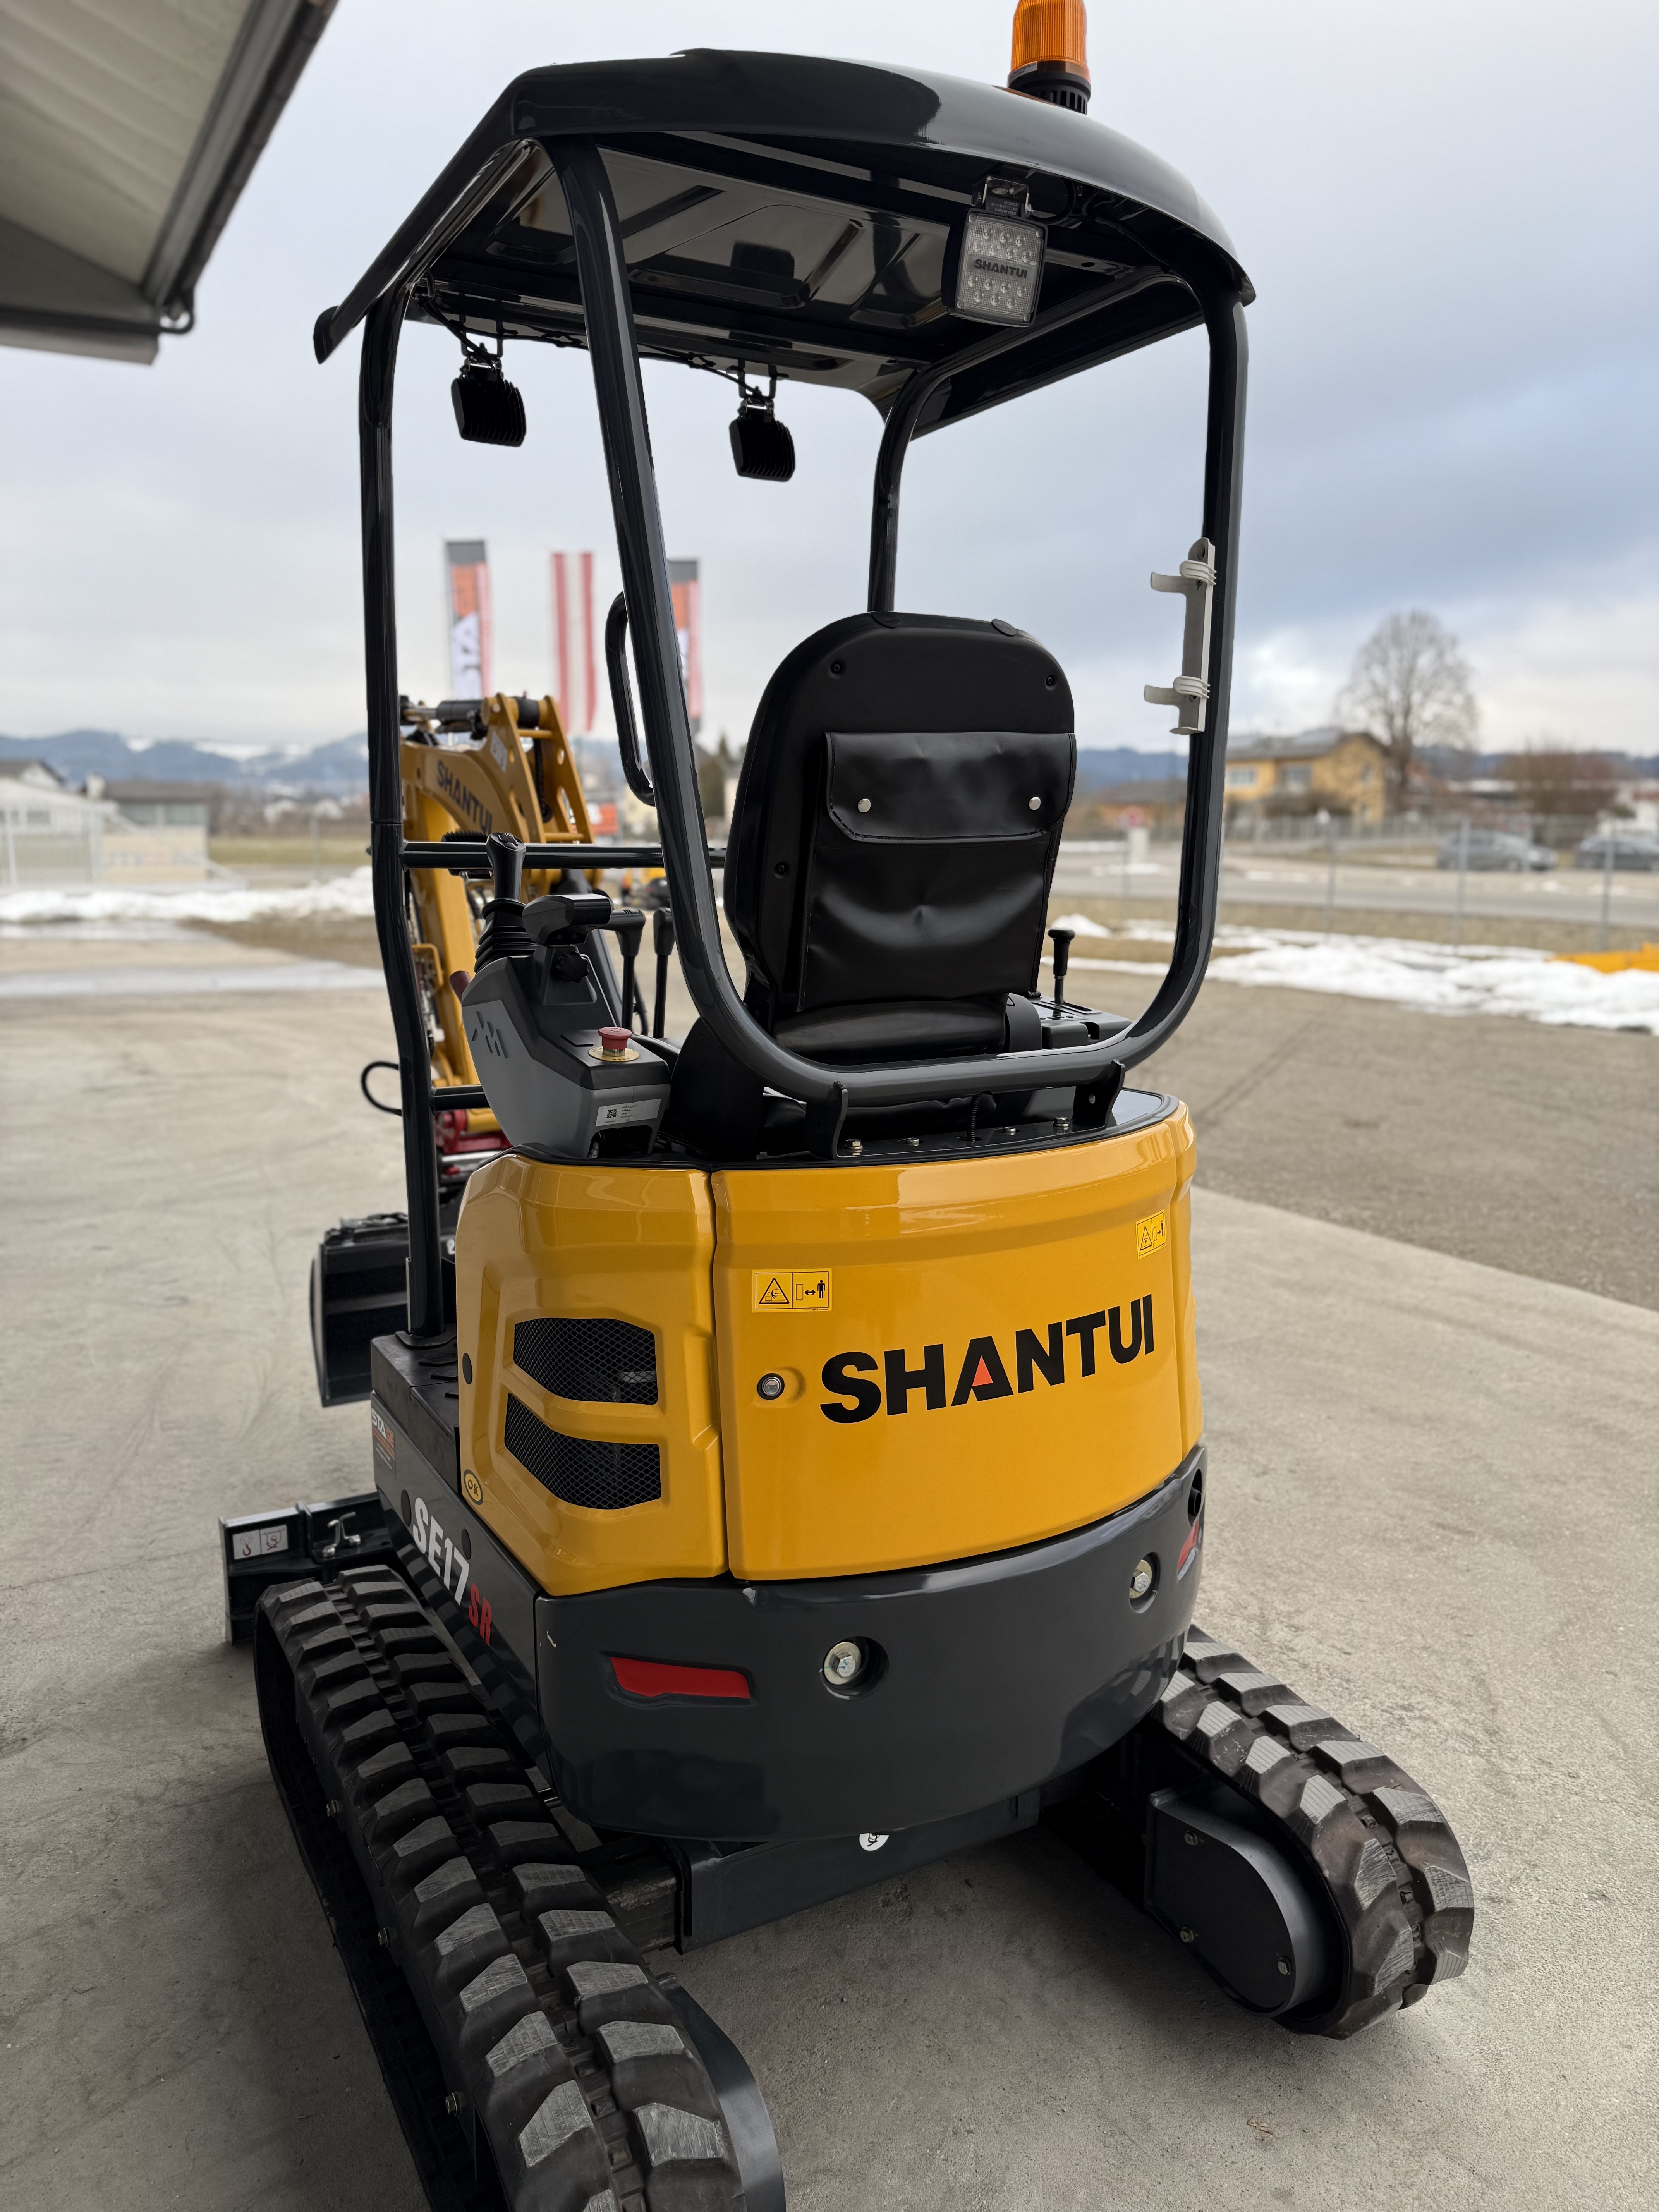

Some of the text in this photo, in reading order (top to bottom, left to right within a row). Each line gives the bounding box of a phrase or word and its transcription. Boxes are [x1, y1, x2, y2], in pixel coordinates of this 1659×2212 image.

[974, 259, 1027, 278] SHANTUI
[437, 759, 492, 834] SHANTUI
[820, 1294, 1154, 1424] SHANTUI
[468, 1479, 478, 1497] OK
[413, 1497, 492, 1647] SE17 SR
